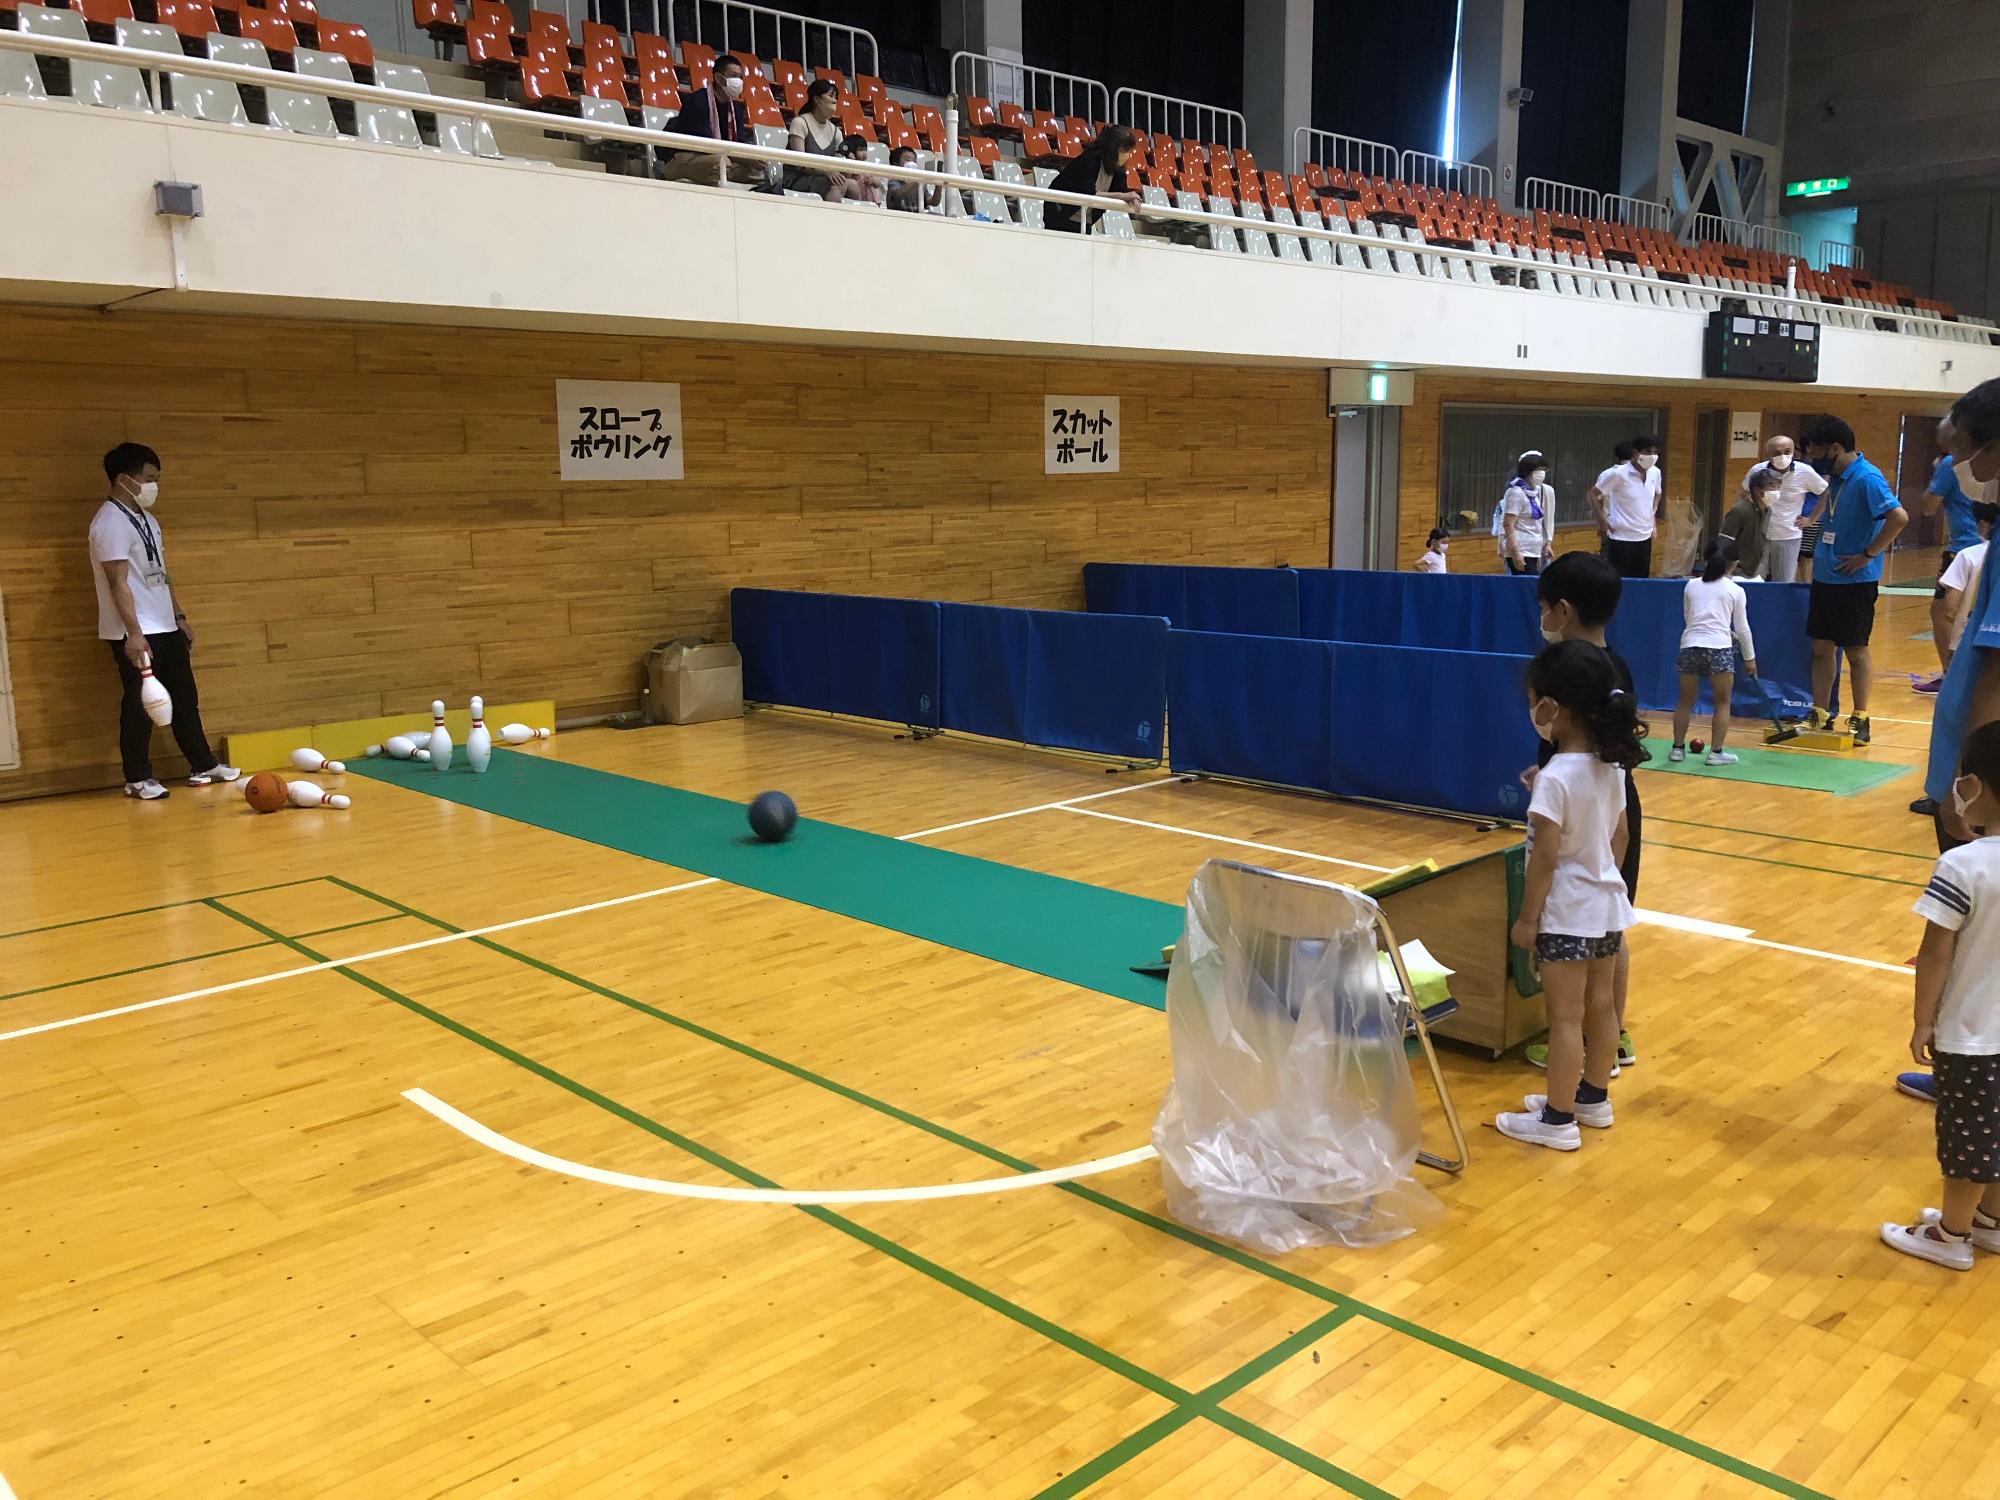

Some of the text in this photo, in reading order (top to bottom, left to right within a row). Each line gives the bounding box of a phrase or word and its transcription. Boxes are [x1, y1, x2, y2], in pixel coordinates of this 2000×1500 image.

[579, 406, 663, 432] スロープ
[1052, 408, 1113, 435] スカット
[571, 433, 673, 460] ボウリング
[1056, 437, 1109, 464] ボール
